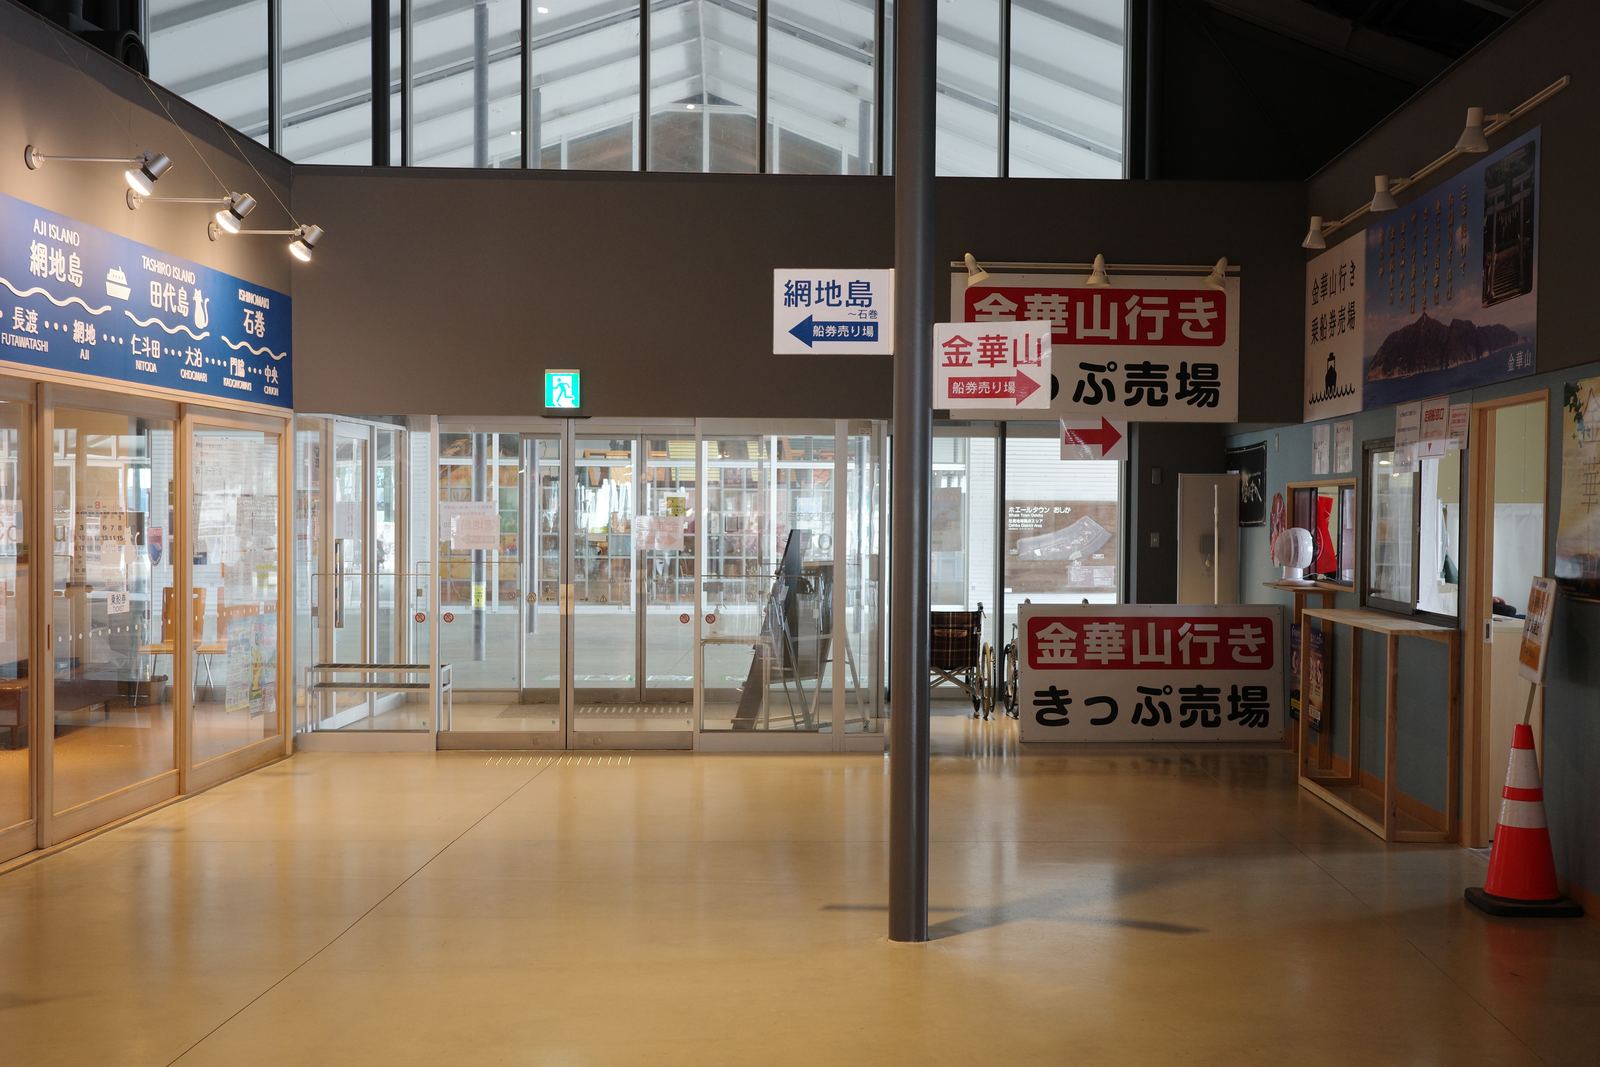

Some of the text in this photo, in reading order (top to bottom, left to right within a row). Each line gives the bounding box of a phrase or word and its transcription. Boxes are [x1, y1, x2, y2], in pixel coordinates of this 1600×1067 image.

[33, 218, 80, 247] AJI ISLAND
[29, 239, 83, 288] 網地島
[141, 255, 196, 286] TASHIRO ISLAND
[783, 279, 873, 308] 網地島
[1311, 260, 1356, 306] 金華山行き
[150, 280, 189, 318] 田代島
[238, 288, 270, 310] ISHINOMAKI
[12, 306, 38, 334] 長渡
[243, 308, 266, 338] 石巻
[973, 292, 1219, 341] 金華山行き
[1311, 300, 1356, 344] 乗船券売場
[1, 332, 49, 353] FUTAWATASHI
[73, 319, 97, 346] 網地
[812, 325, 874, 338] 船券売り場
[79, 348, 90, 360] AJI
[131, 333, 161, 359] 仁斗田
[185, 346, 203, 368] 大泊
[941, 333, 1042, 368] 金華山
[135, 359, 158, 373] NITODA
[1507, 348, 1532, 372] 金華山
[264, 364, 279, 385] 中央
[952, 381, 1016, 394] 船券売り場
[1008, 506, 1072, 514] ホエールタウン おしか
[1035, 621, 1267, 665] 金華山行き
